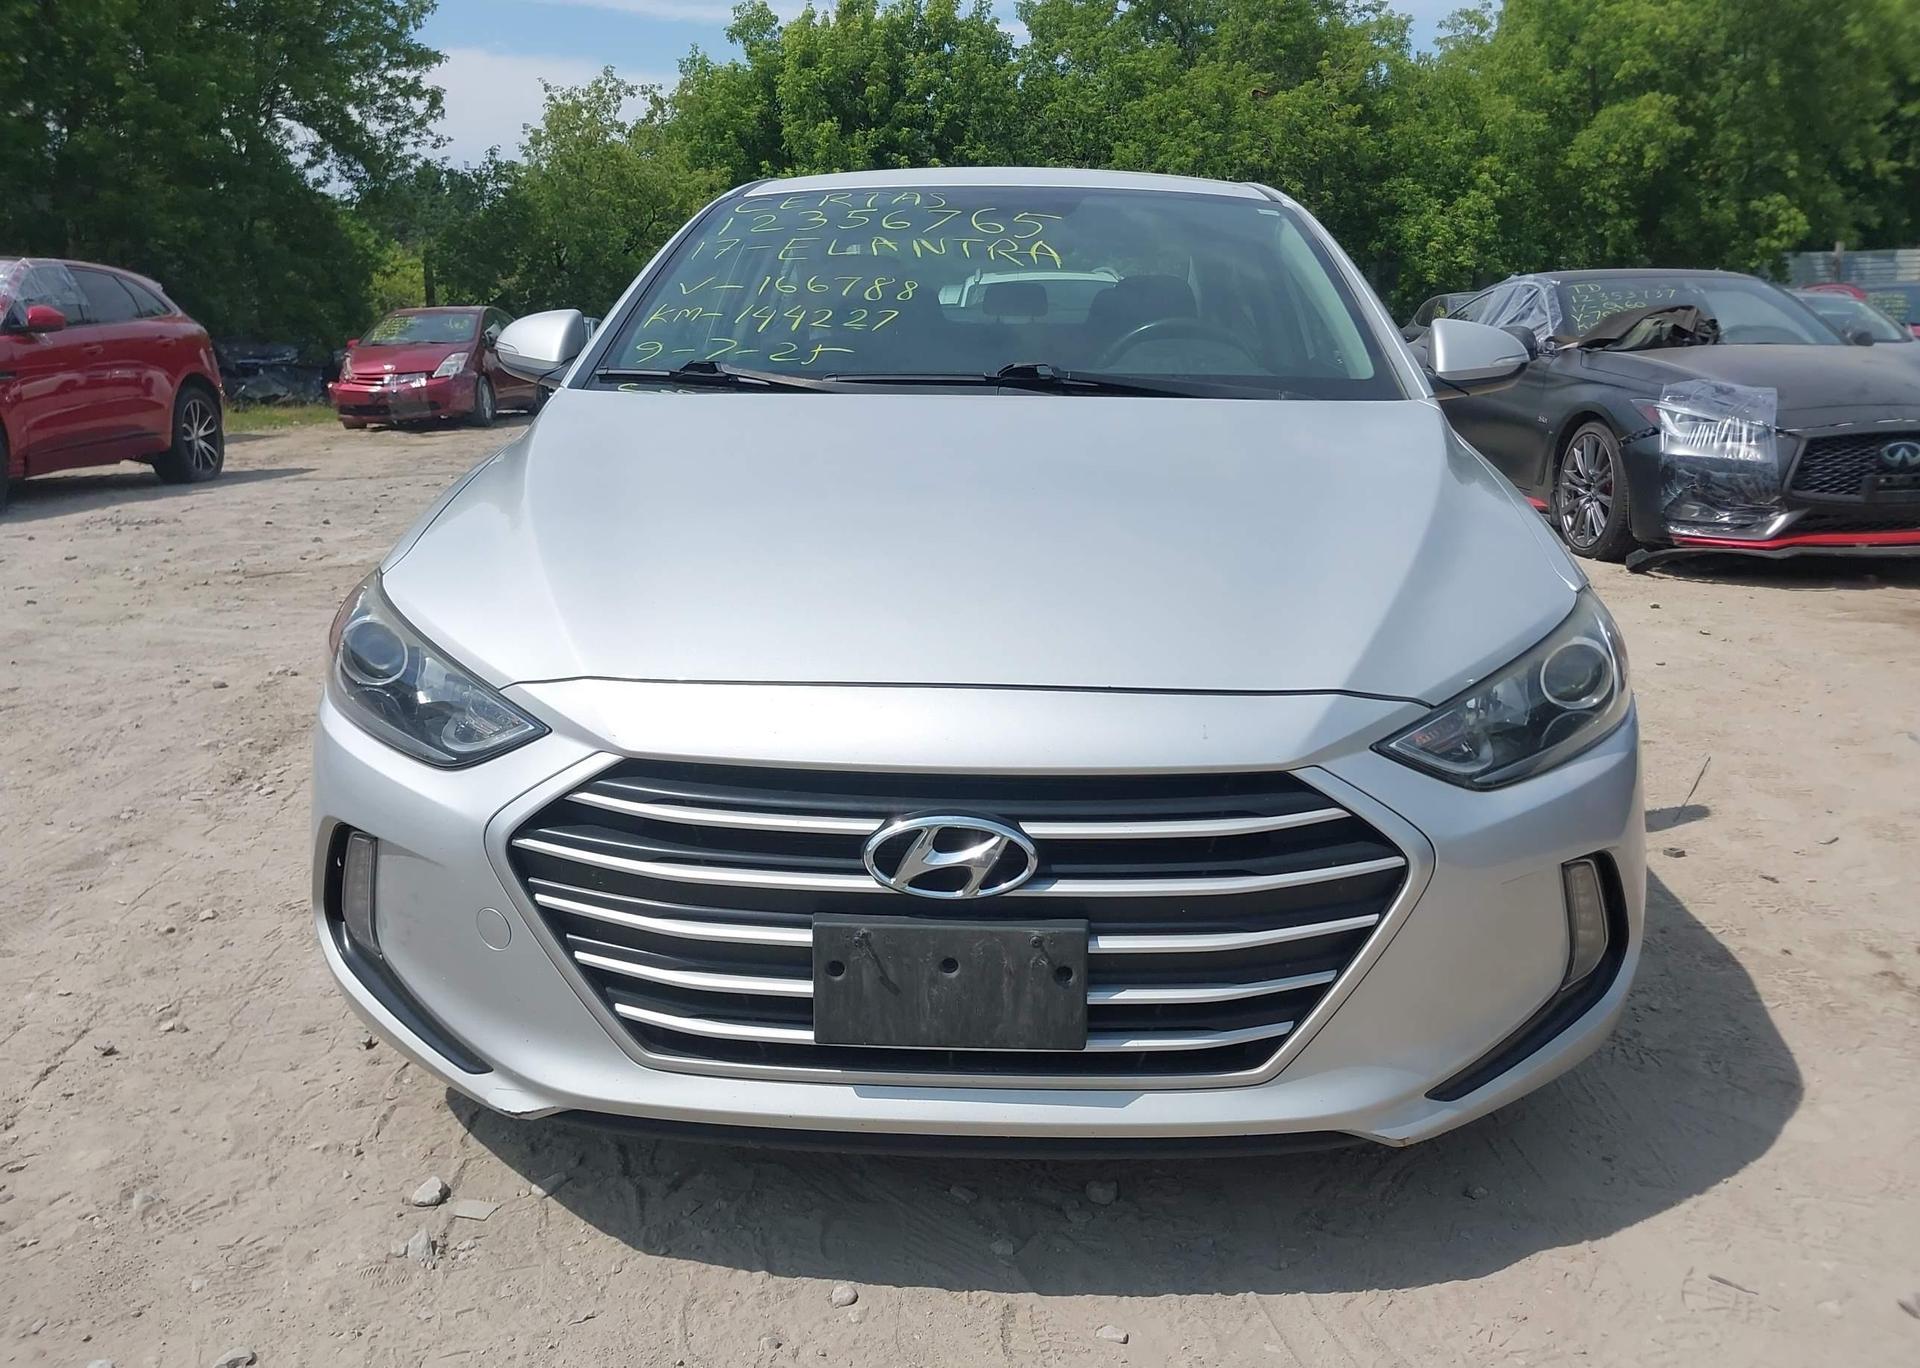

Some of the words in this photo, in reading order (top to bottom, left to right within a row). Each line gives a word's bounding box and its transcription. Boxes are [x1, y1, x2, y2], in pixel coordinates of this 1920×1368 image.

[734, 193, 946, 213] CERTAS
[718, 208, 1063, 239] 12356765
[690, 236, 1063, 269] 17-ELANTRA
[679, 275, 919, 301] V-166788
[643, 303, 900, 333] KM-144227
[635, 338, 855, 366] 9-7-25
